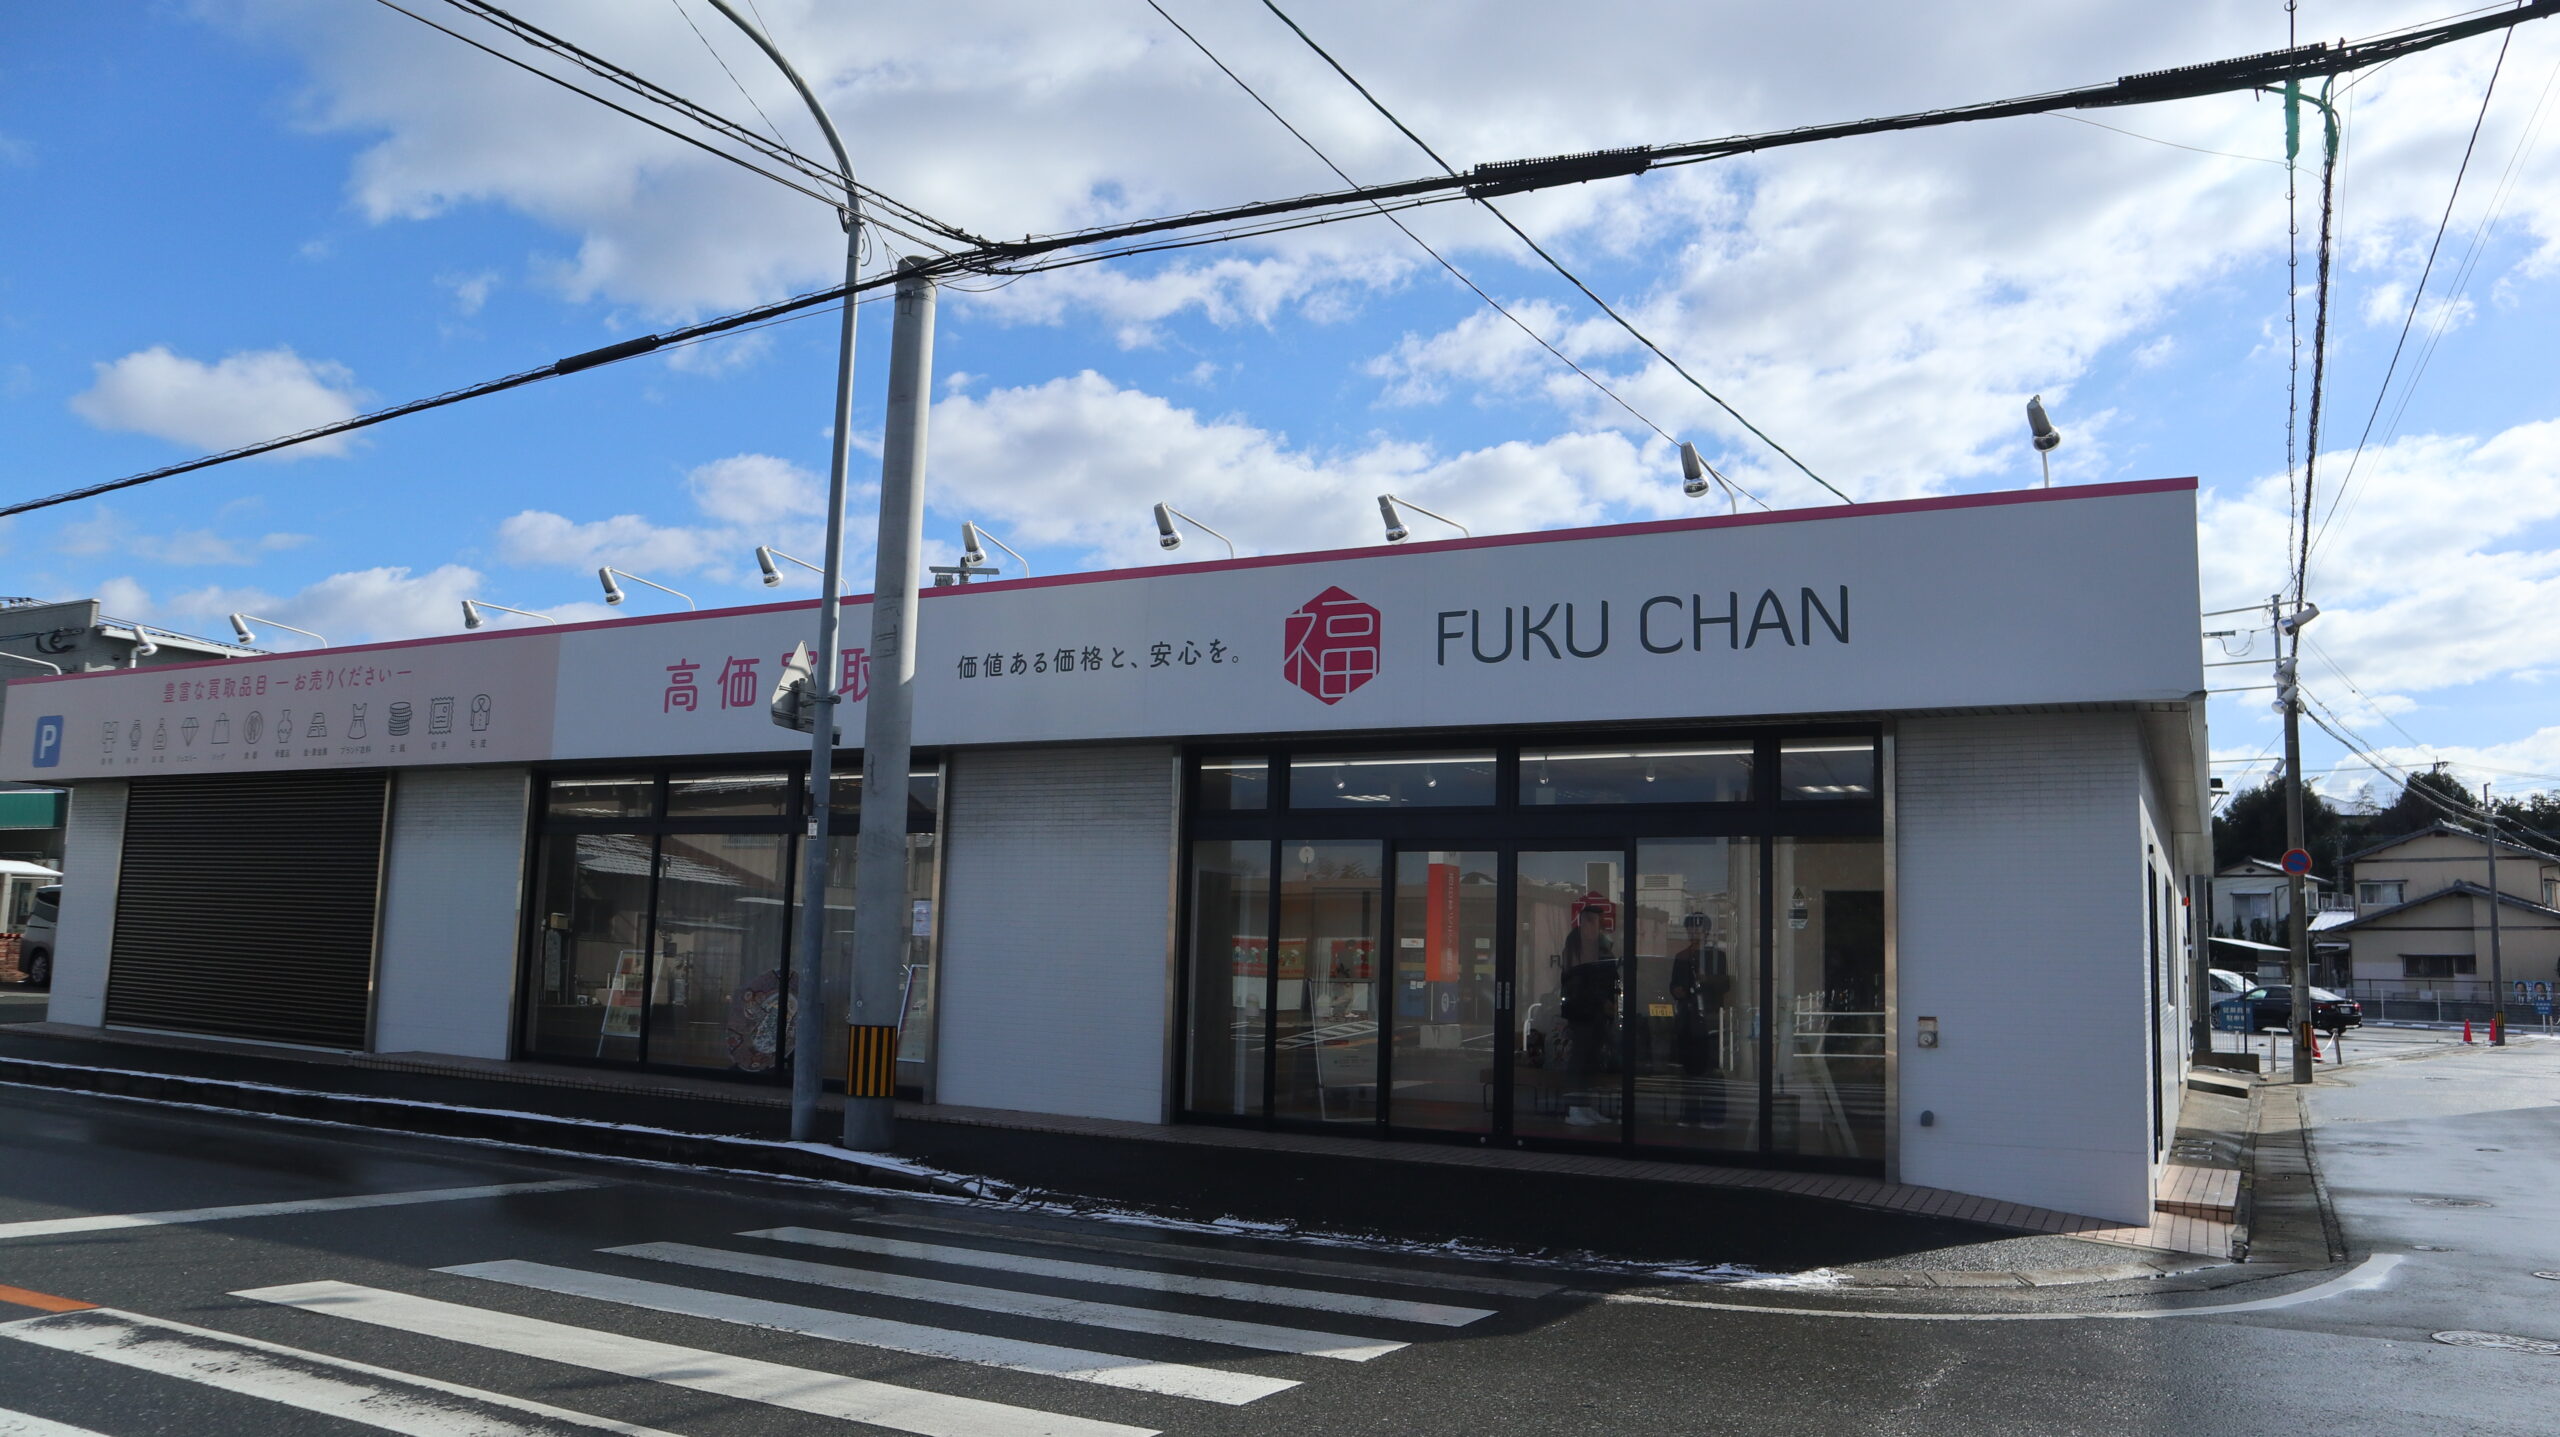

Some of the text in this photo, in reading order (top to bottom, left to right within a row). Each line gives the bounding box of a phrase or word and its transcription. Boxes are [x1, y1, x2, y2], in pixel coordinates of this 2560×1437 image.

[1284, 592, 1380, 702] 福
[1437, 584, 1849, 666] FUKU CHAN
[664, 647, 872, 714] 高価取
[957, 638, 1241, 680] 価値ある価格と、安心を。
[163, 675, 268, 703] 豊富な買取品目
[39, 724, 57, 759] P
